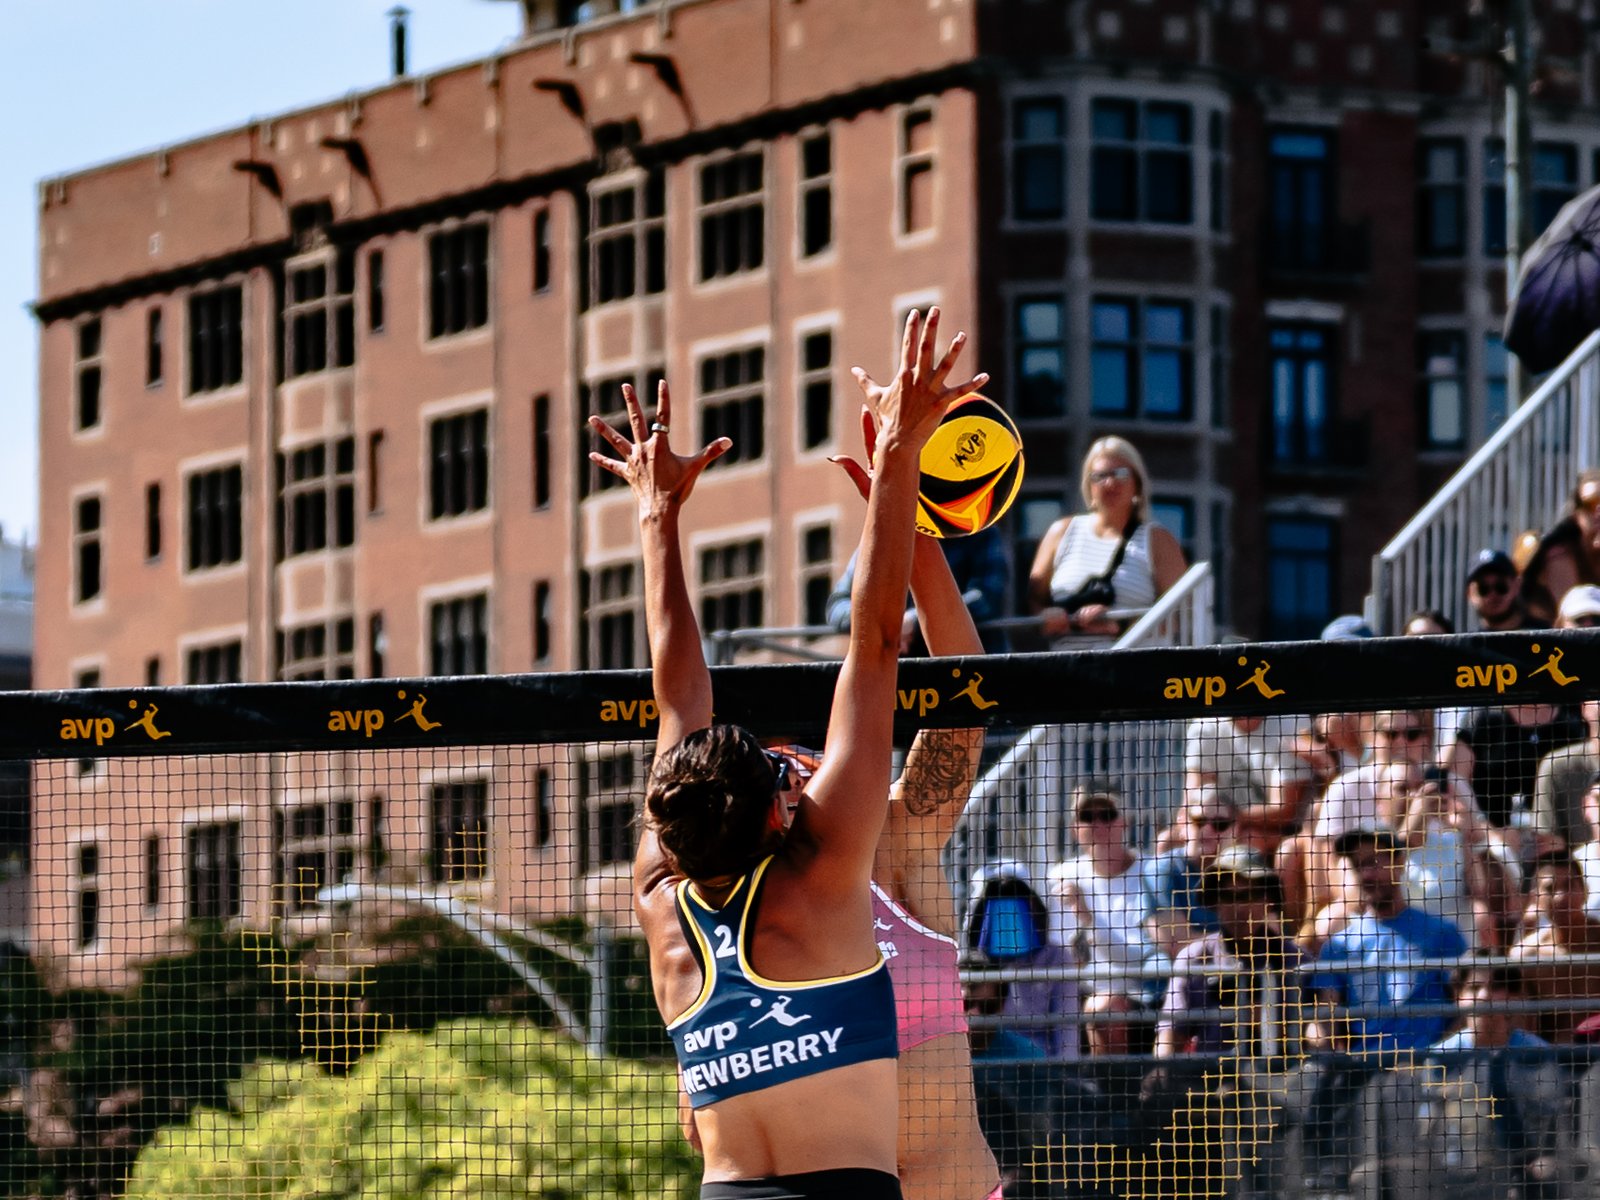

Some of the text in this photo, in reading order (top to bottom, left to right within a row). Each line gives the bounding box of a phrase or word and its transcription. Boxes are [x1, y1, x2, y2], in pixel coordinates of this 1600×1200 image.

[1163, 676, 1227, 706] avp
[1455, 663, 1518, 691] avp
[600, 699, 660, 728] avp
[894, 688, 939, 717] vp
[60, 717, 115, 746] avp
[327, 709, 385, 738] avp
[714, 925, 736, 958] 2
[683, 1021, 738, 1053] avp
[682, 1027, 844, 1095] NEWBERRY
